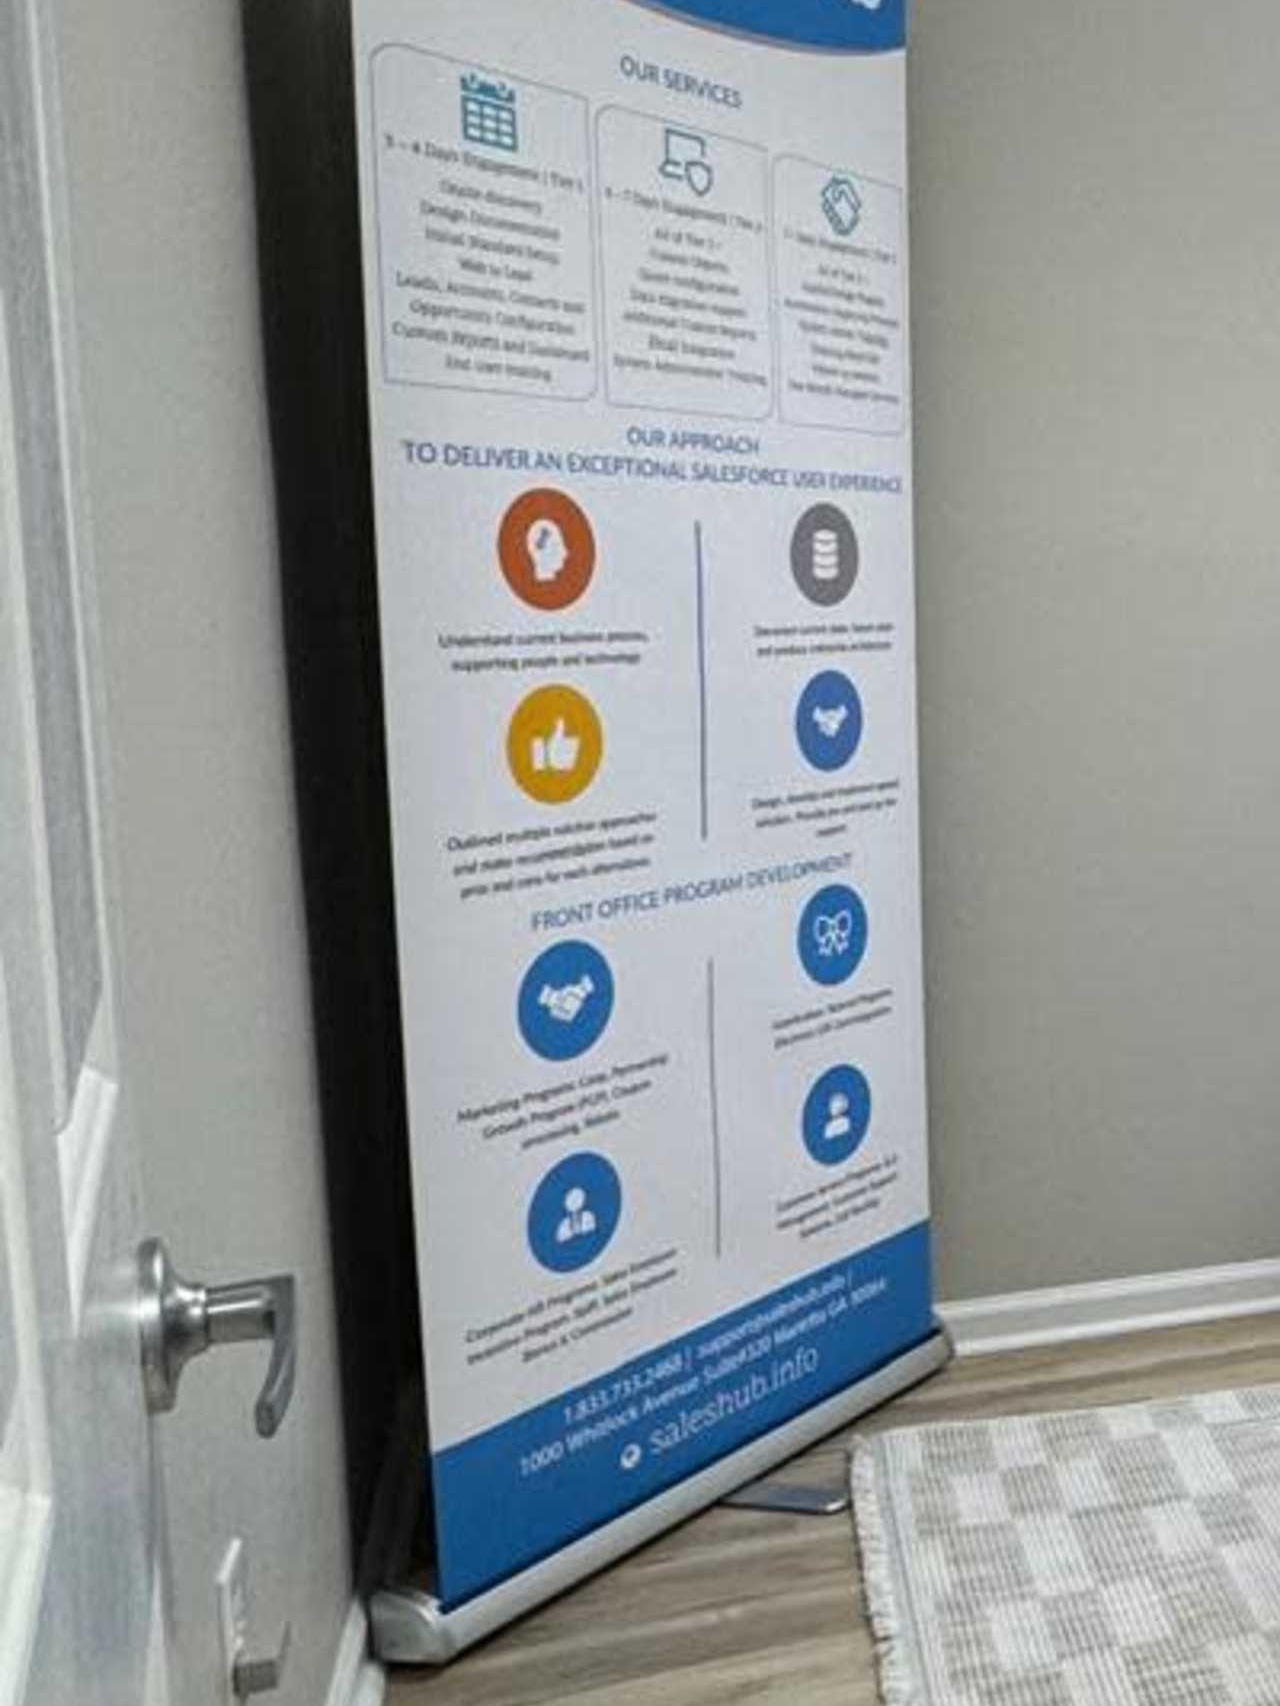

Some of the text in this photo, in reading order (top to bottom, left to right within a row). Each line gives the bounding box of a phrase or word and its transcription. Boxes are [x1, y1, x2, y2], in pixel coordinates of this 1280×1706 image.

[619, 55, 743, 109] OUR SERVICES
[626, 426, 760, 455] OUR APPROACH
[401, 441, 904, 495] TO DELIVER AN EXCEPTIONAL SALESFORCE USER EXPERIENCE
[531, 851, 853, 931] FRONT OFFICE PROGRAM DEVELOPMENT
[650, 1346, 818, 1451] saleshub.info
[519, 1440, 564, 1478] 1000
